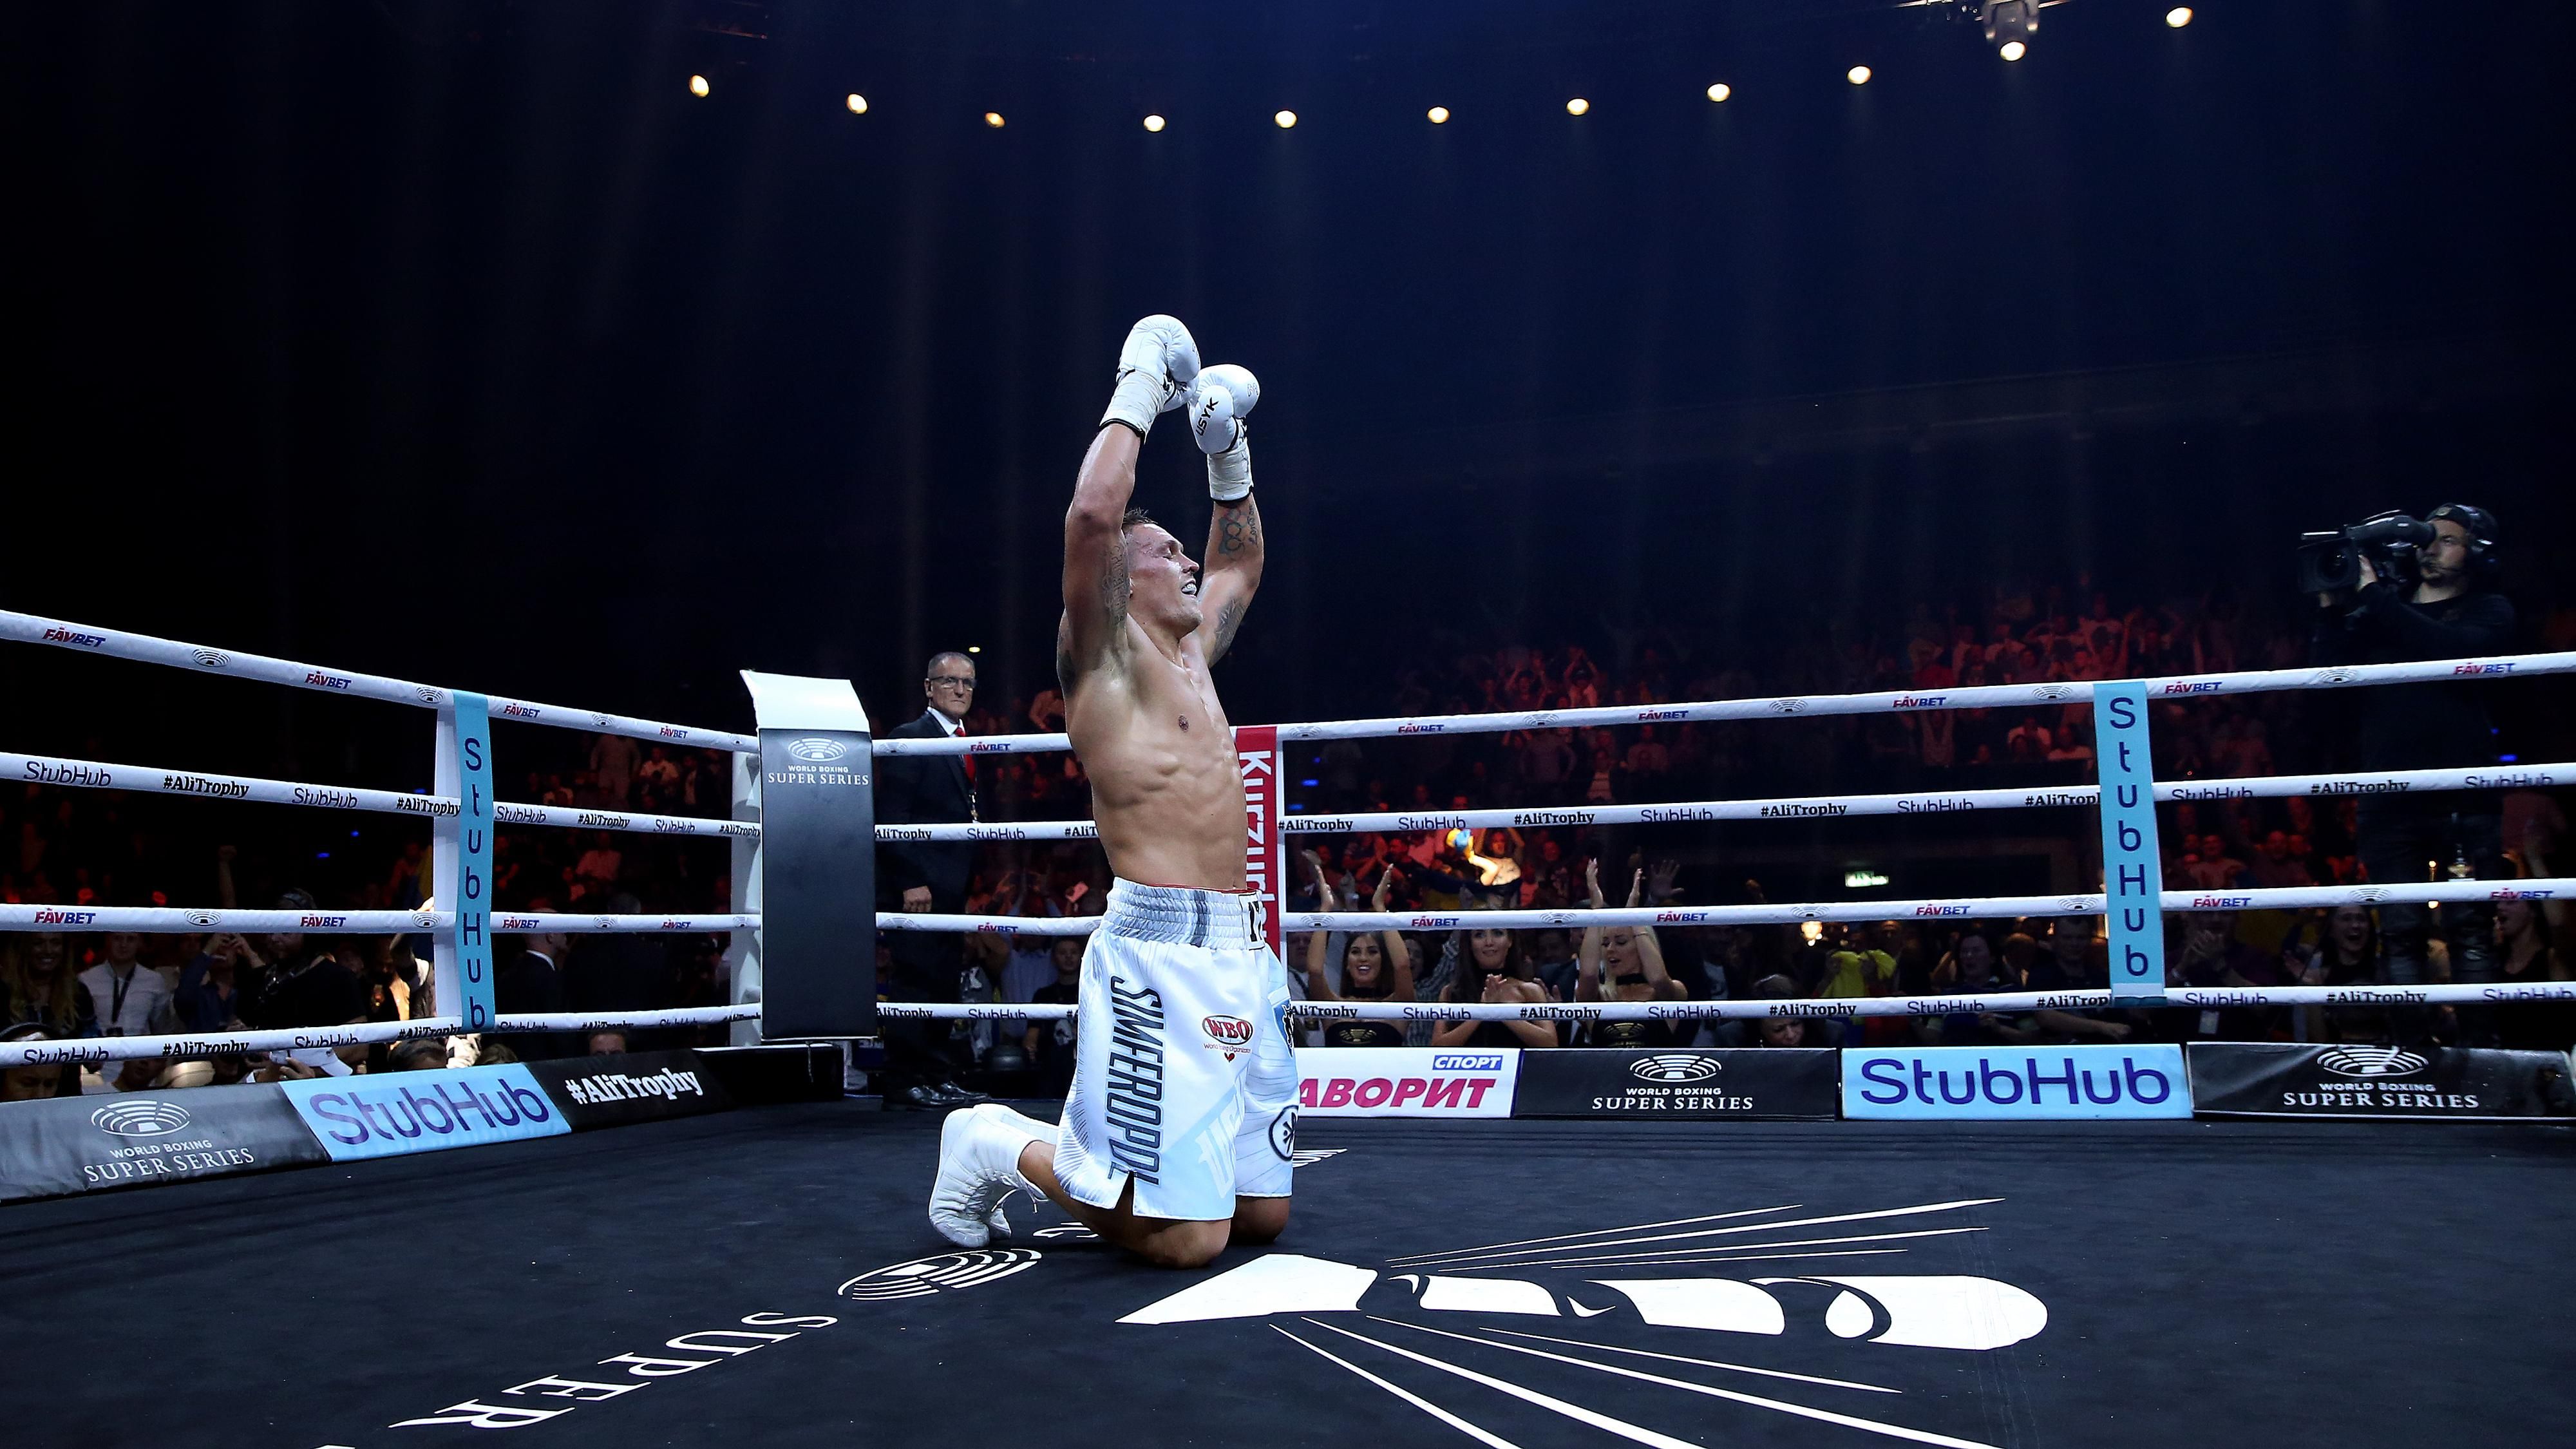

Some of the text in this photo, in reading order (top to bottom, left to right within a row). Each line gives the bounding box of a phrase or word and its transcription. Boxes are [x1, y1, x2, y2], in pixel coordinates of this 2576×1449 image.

[1196, 397, 1219, 436] USYK
[43, 627, 106, 647] FAVBET
[2453, 663, 2516, 675] FAVBET
[305, 672, 352, 690] FAVBET
[2165, 681, 2222, 694] FAVBET
[1893, 697, 1946, 708] FAVBET
[504, 705, 540, 718] FAVBET
[1638, 710, 1689, 721] FAVBET
[659, 727, 688, 739] FAVBET
[971, 743, 1010, 752] FAVBET
[23, 761, 111, 787] StubHub
[768, 773, 869, 785] SUPER SERIES
[163, 774, 249, 798] #AliTrophy
[2172, 786, 2253, 800] StubHub
[2311, 779, 2410, 795] #AliTrophy
[292, 787, 358, 809] StubHub
[396, 797, 461, 817] #AliTrophy
[1761, 803, 1847, 817] #AliTrophy
[1897, 798, 1974, 813] StubHub
[494, 806, 546, 824] StubHub
[578, 813, 630, 830] #AliTrophy
[1514, 811, 1595, 825] #AliTrophy
[1641, 808, 1713, 821] StubHub
[1278, 819, 1353, 831] #AliTrophy
[1399, 817, 1466, 829] StubHub
[875, 828, 932, 840] AliTrophy
[967, 828, 1025, 840] StubHub
[2110, 696, 2148, 977] StubHub
[463, 737, 486, 1029] StubHub
[2193, 897, 2251, 907] FAVBET
[34, 912, 96, 924] FAVBET
[1656, 913, 1708, 922] FAVBET
[1916, 906, 1971, 916] FAVBET
[299, 916, 346, 927] FAVBET
[502, 920, 539, 929] FAVBET
[1411, 918, 1459, 927] FAVBET
[2185, 992, 2268, 1007] StubHub
[2326, 990, 2427, 1005] #AliTrophy
[876, 1008, 933, 1018] AliTrophy
[1292, 1005, 1358, 1019] AliTrophy
[1403, 1007, 1472, 1019] StubHub
[1520, 1007, 1602, 1020] #AliTrophy
[1648, 1006, 1721, 1019] StubHub
[1769, 1003, 1857, 1018] #AliTrophy
[1907, 999, 1985, 1015] StubHub
[969, 1009, 1027, 1020] StubHub
[1205, 1018, 1251, 1041] WBO
[162, 1040, 249, 1057] #AliTrophy
[23, 1046, 109, 1066] StubHub
[1434, 1056, 1502, 1069] СПОРТ
[565, 1067, 703, 1105] #AliTrophy
[1107, 975, 1164, 1186] SIMFEROPOL
[1861, 1057, 2170, 1105] StubHub
[2318, 1083, 2436, 1092] WORLD BOXING
[1299, 1078, 1496, 1108] АВОРИТ
[2284, 1092, 2479, 1108] SUPER SERIES
[1592, 1097, 1754, 1110] SUPER SERIES
[310, 1078, 550, 1146] StubHub
[110, 1139, 213, 1159] WORLD BOXING
[84, 1146, 255, 1182] SUPER SERIES
[388, 1312, 838, 1428] SUPER
